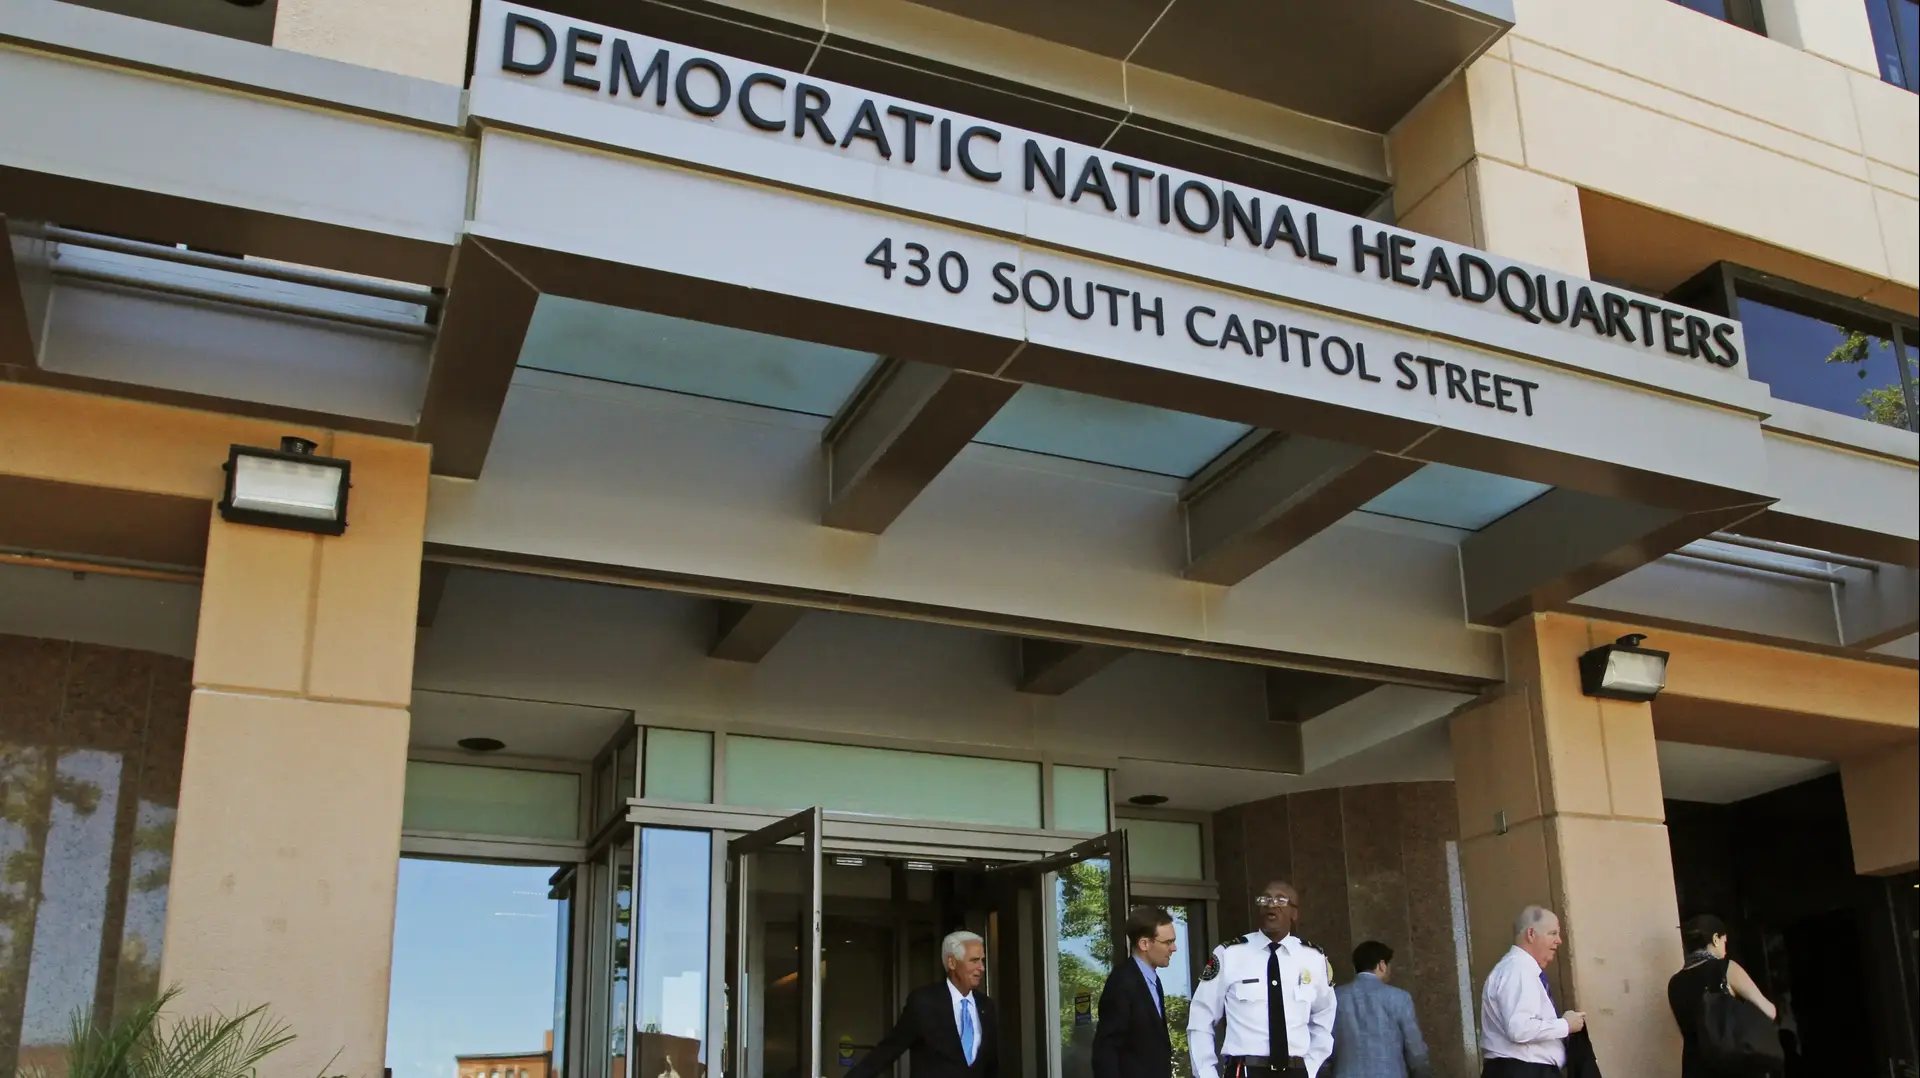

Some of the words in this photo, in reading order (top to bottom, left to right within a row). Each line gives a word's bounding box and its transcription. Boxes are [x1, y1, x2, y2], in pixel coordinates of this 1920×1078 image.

[501, 12, 1002, 182] DEMOCRATIC
[1024, 138, 1337, 265] NATIONAL
[1352, 224, 1739, 368] HEADQUARTERS
[865, 237, 969, 293] 430
[992, 261, 1164, 336] SOUTH
[1186, 306, 1381, 382] CAPITOL
[1394, 351, 1539, 417] STREET
